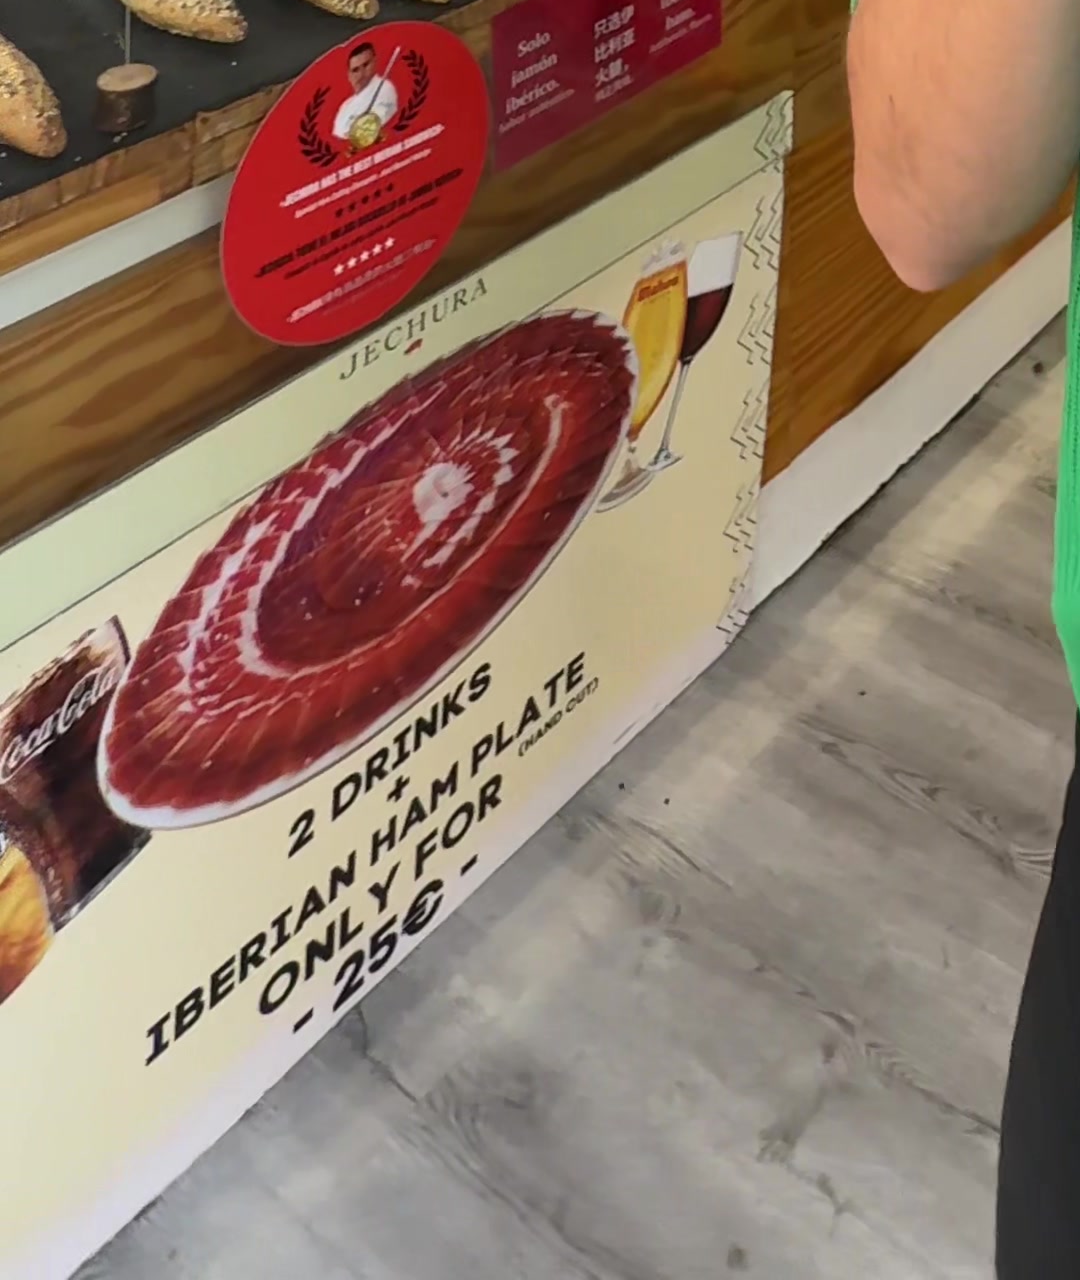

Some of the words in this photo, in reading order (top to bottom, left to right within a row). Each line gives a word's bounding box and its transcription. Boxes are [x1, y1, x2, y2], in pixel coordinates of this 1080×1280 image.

[511, 53, 558, 89] jamón
[517, 32, 550, 57] Solo
[339, 278, 488, 380] JECHURA
[0, 655, 123, 785] Coca-Cola
[288, 808, 316, 858] 2
[332, 662, 491, 821] DRINKS
[517, 713, 563, 757] (HAND
[145, 850, 357, 1067] IBERIAN
[370, 761, 458, 867] HAM
[470, 652, 586, 778] PLATE
[258, 861, 401, 1016] ONLY
[414, 773, 503, 881] FOR
[333, 878, 445, 1013] 25€
